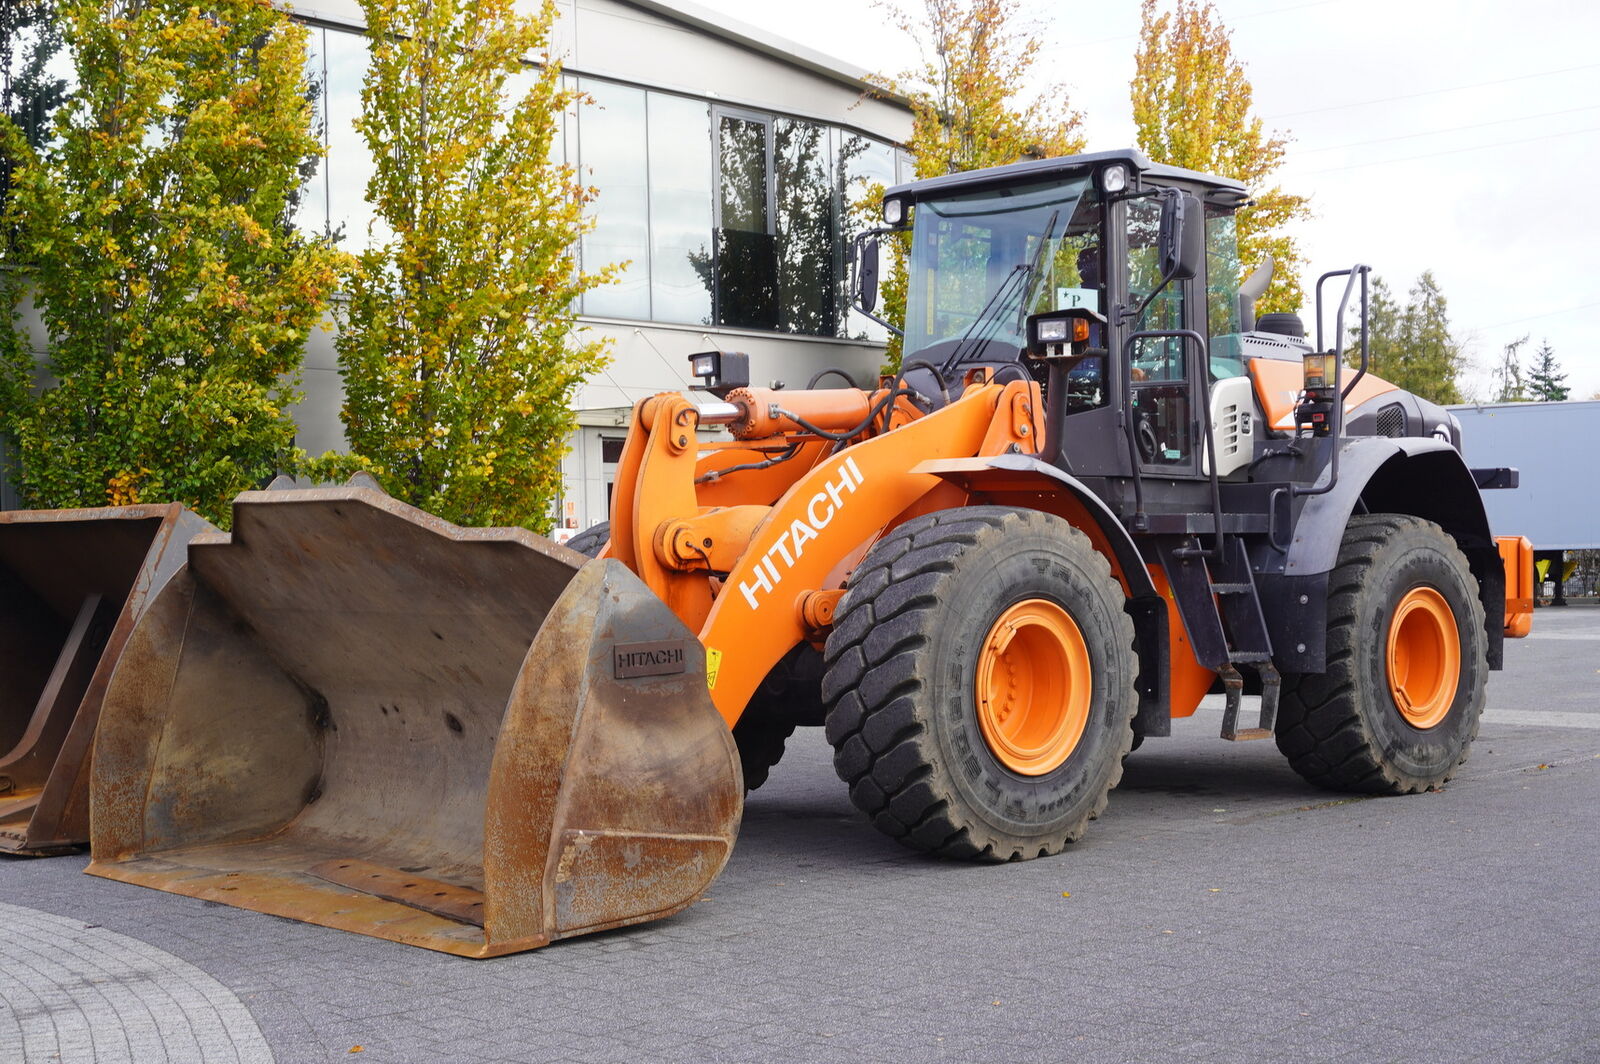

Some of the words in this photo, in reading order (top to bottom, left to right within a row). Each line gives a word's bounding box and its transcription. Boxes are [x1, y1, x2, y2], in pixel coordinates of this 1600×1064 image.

[1072, 295, 1081, 307] P
[738, 455, 865, 611] HITACHI
[618, 648, 683, 668] HITACHI
